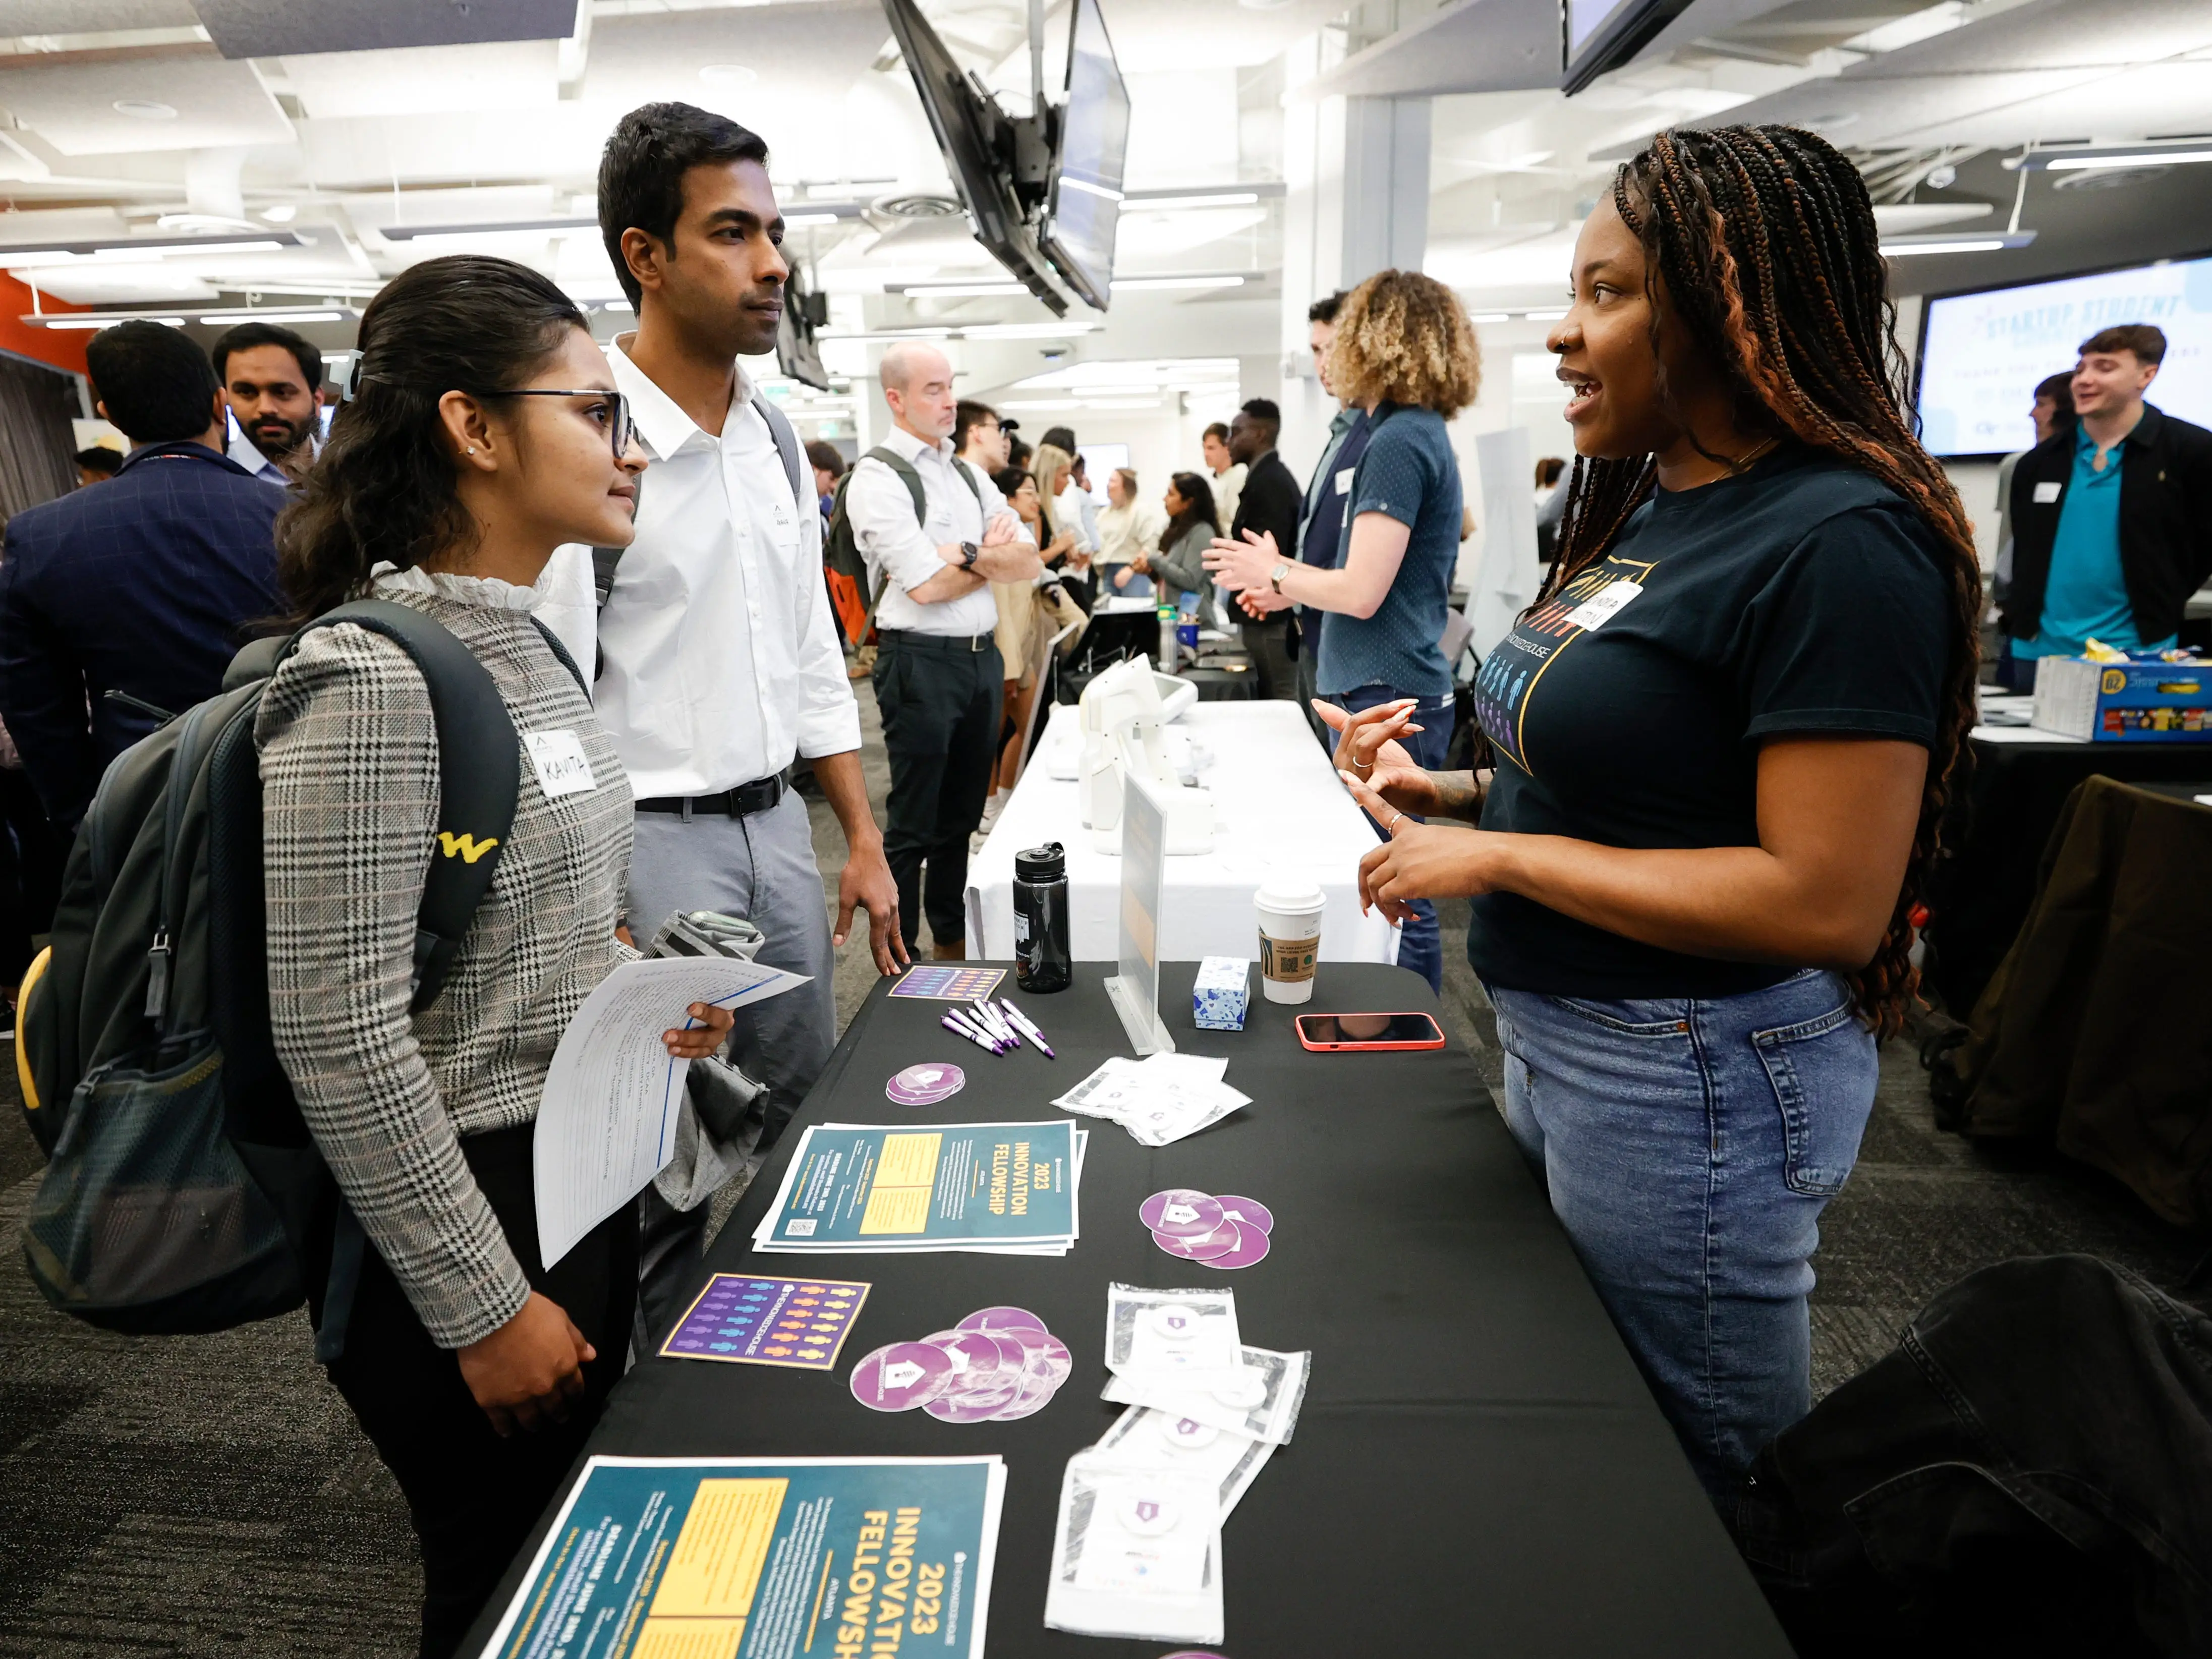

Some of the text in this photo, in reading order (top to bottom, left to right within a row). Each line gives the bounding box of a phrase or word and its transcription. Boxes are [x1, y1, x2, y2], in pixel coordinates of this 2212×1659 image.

[543, 756, 588, 781] KAVITA
[828, 1153, 842, 1174] DEADLINE
[987, 1144, 1009, 1215] FELLOWSHIP
[1010, 1142, 1030, 1215] INNOVATION
[1033, 1162, 1050, 1189] 2023
[824, 1174, 835, 1186] JUNE
[587, 1524, 623, 1579] DEADLINE
[572, 1581, 598, 1613] JUNE
[821, 1577, 840, 1620] ATLANTA
[909, 1563, 946, 1634] 2023
[557, 1615, 582, 1646] 2ND,
